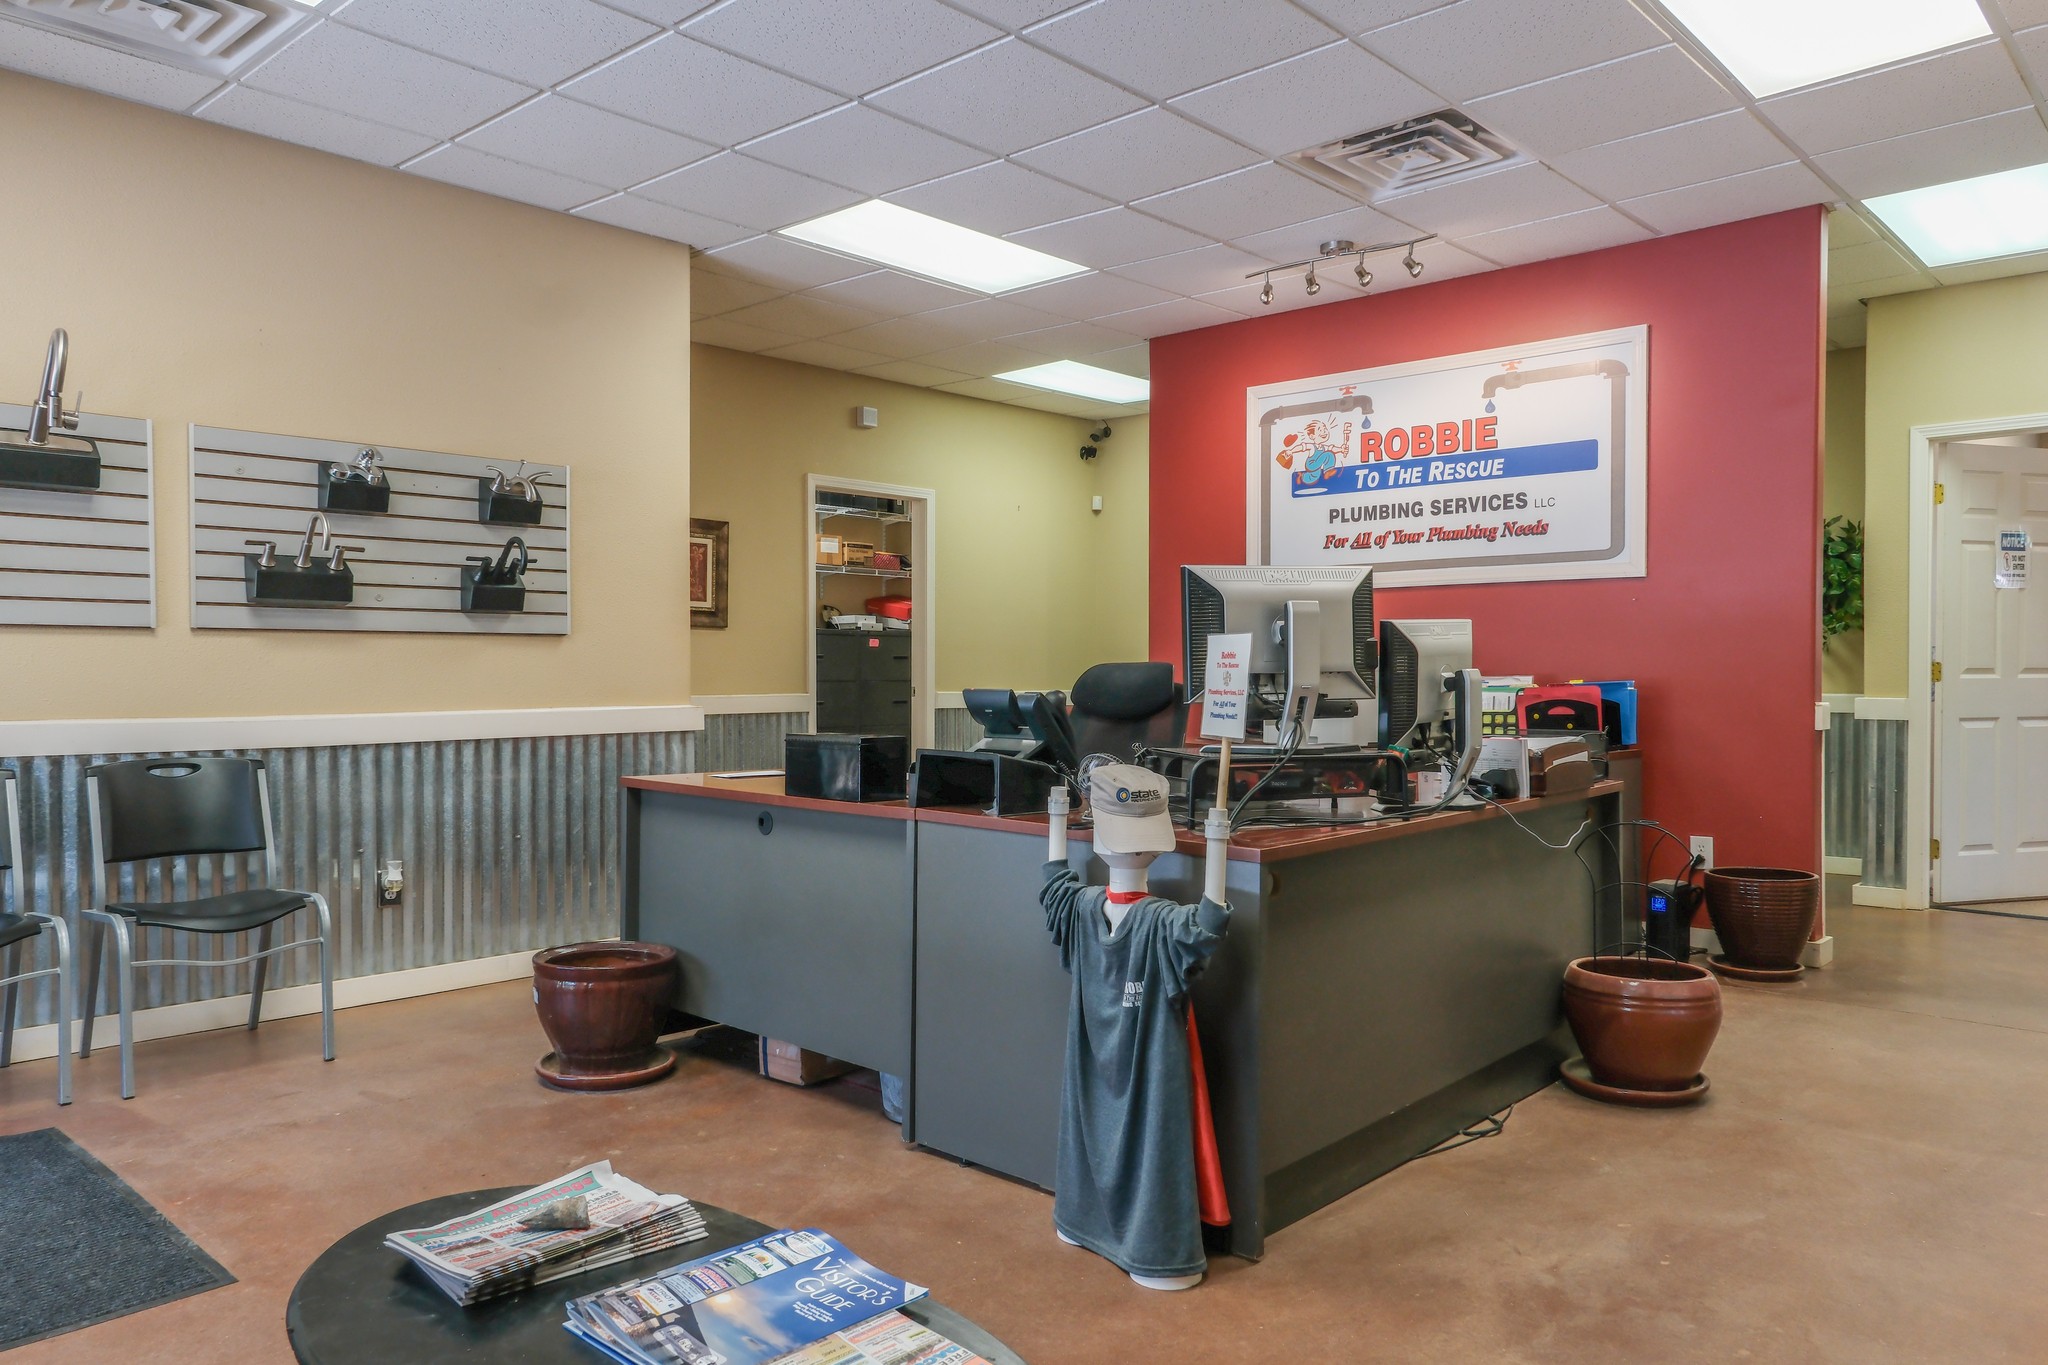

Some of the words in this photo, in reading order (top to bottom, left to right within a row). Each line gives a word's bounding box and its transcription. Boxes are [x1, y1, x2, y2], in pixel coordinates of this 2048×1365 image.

[1360, 416, 1499, 463] ROBBIE
[1329, 501, 1424, 524] PLUMBING
[1430, 491, 1528, 517] SERVICES
[1534, 496, 1556, 509] LLC
[1323, 533, 1350, 550] For
[1351, 531, 1373, 550] All
[1374, 530, 1391, 549] of
[1392, 527, 1427, 546] Your
[1427, 523, 1499, 544] Plumbing
[1501, 519, 1550, 539] Needs
[2002, 536, 2025, 548] NOTICE
[1208, 689, 1223, 697] Plumbing
[1210, 712, 1225, 720] Plumbing
[1131, 789, 1160, 799] state
[795, 1277, 856, 1312] GUIDE
